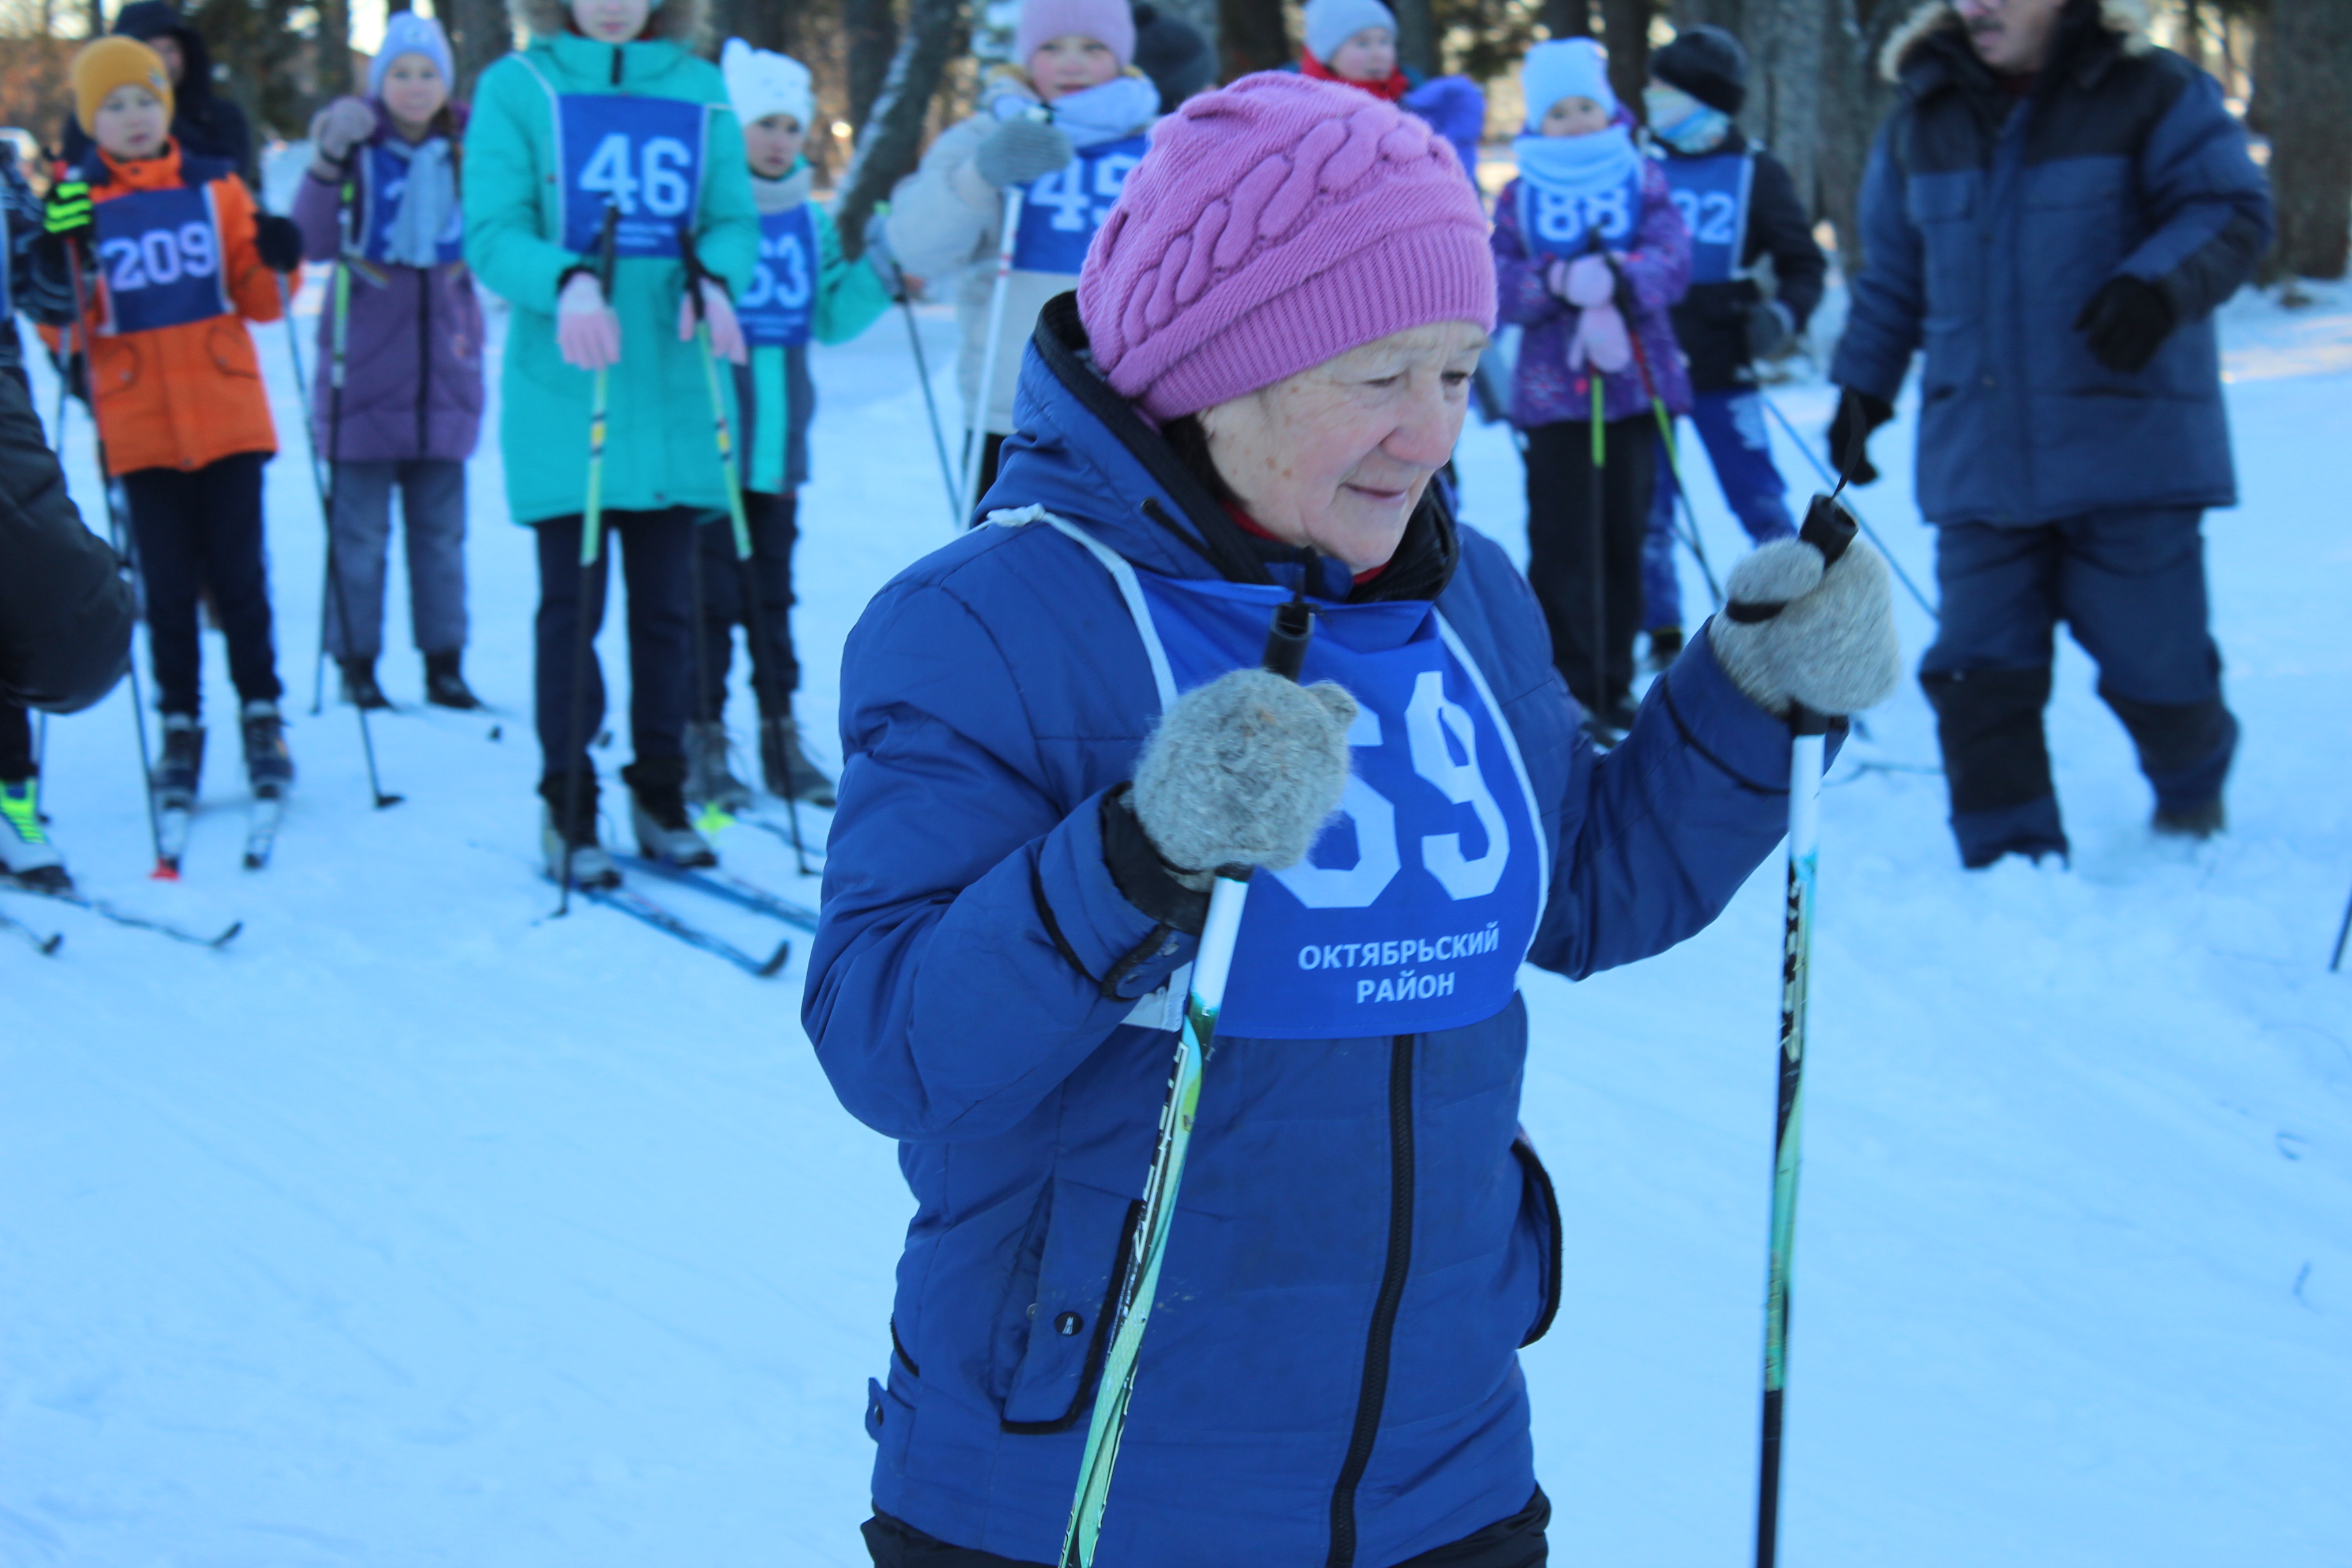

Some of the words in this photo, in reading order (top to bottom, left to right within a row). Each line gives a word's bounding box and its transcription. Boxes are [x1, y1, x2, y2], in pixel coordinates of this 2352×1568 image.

[579, 131, 691, 216] 46
[100, 220, 218, 291] 209
[1297, 920, 1499, 971] ОКТЯБРЬСКИЙ
[1356, 969, 1456, 1004] РАЙОН
